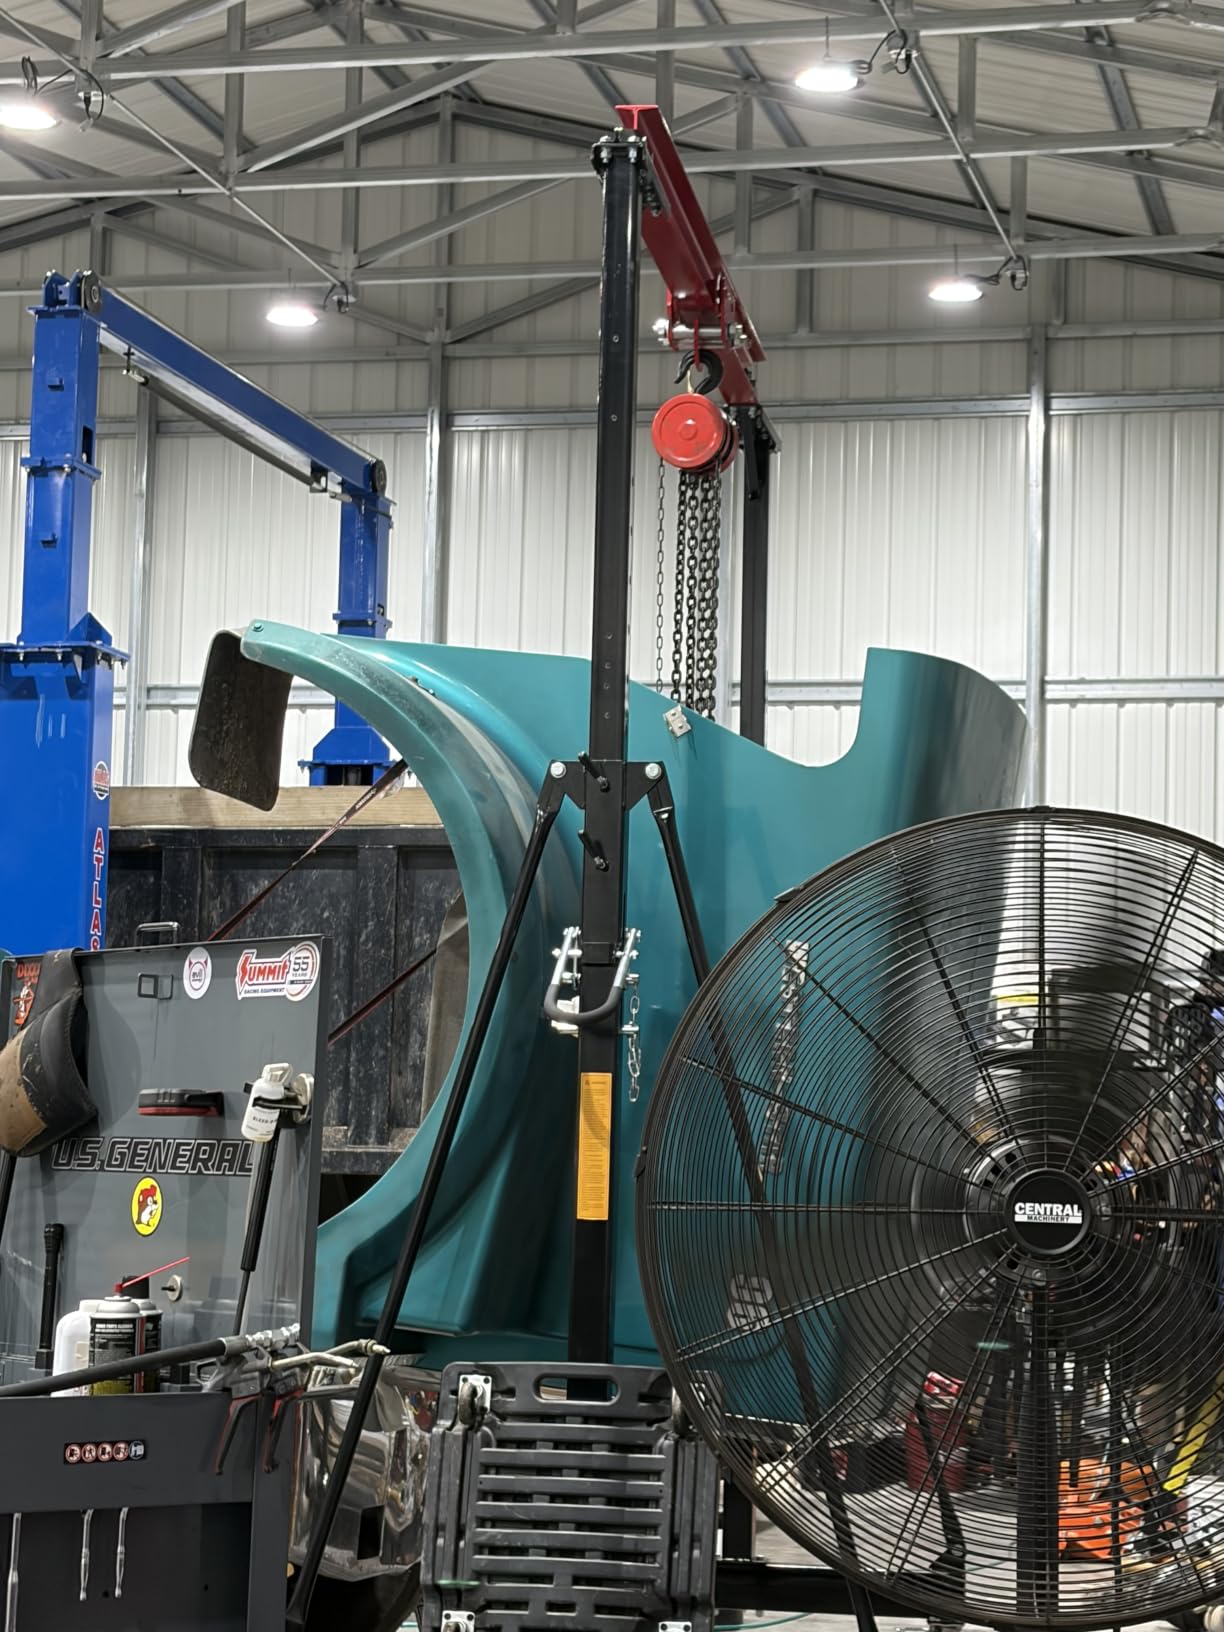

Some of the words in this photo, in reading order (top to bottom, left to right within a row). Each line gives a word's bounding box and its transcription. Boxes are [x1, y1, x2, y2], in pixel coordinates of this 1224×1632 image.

[292, 956, 310, 972] 55
[104, 1137, 254, 1175] GENERAL
[1014, 1202, 1082, 1217] CENTRAL
[1026, 1214, 1071, 1223] MACHINERY
